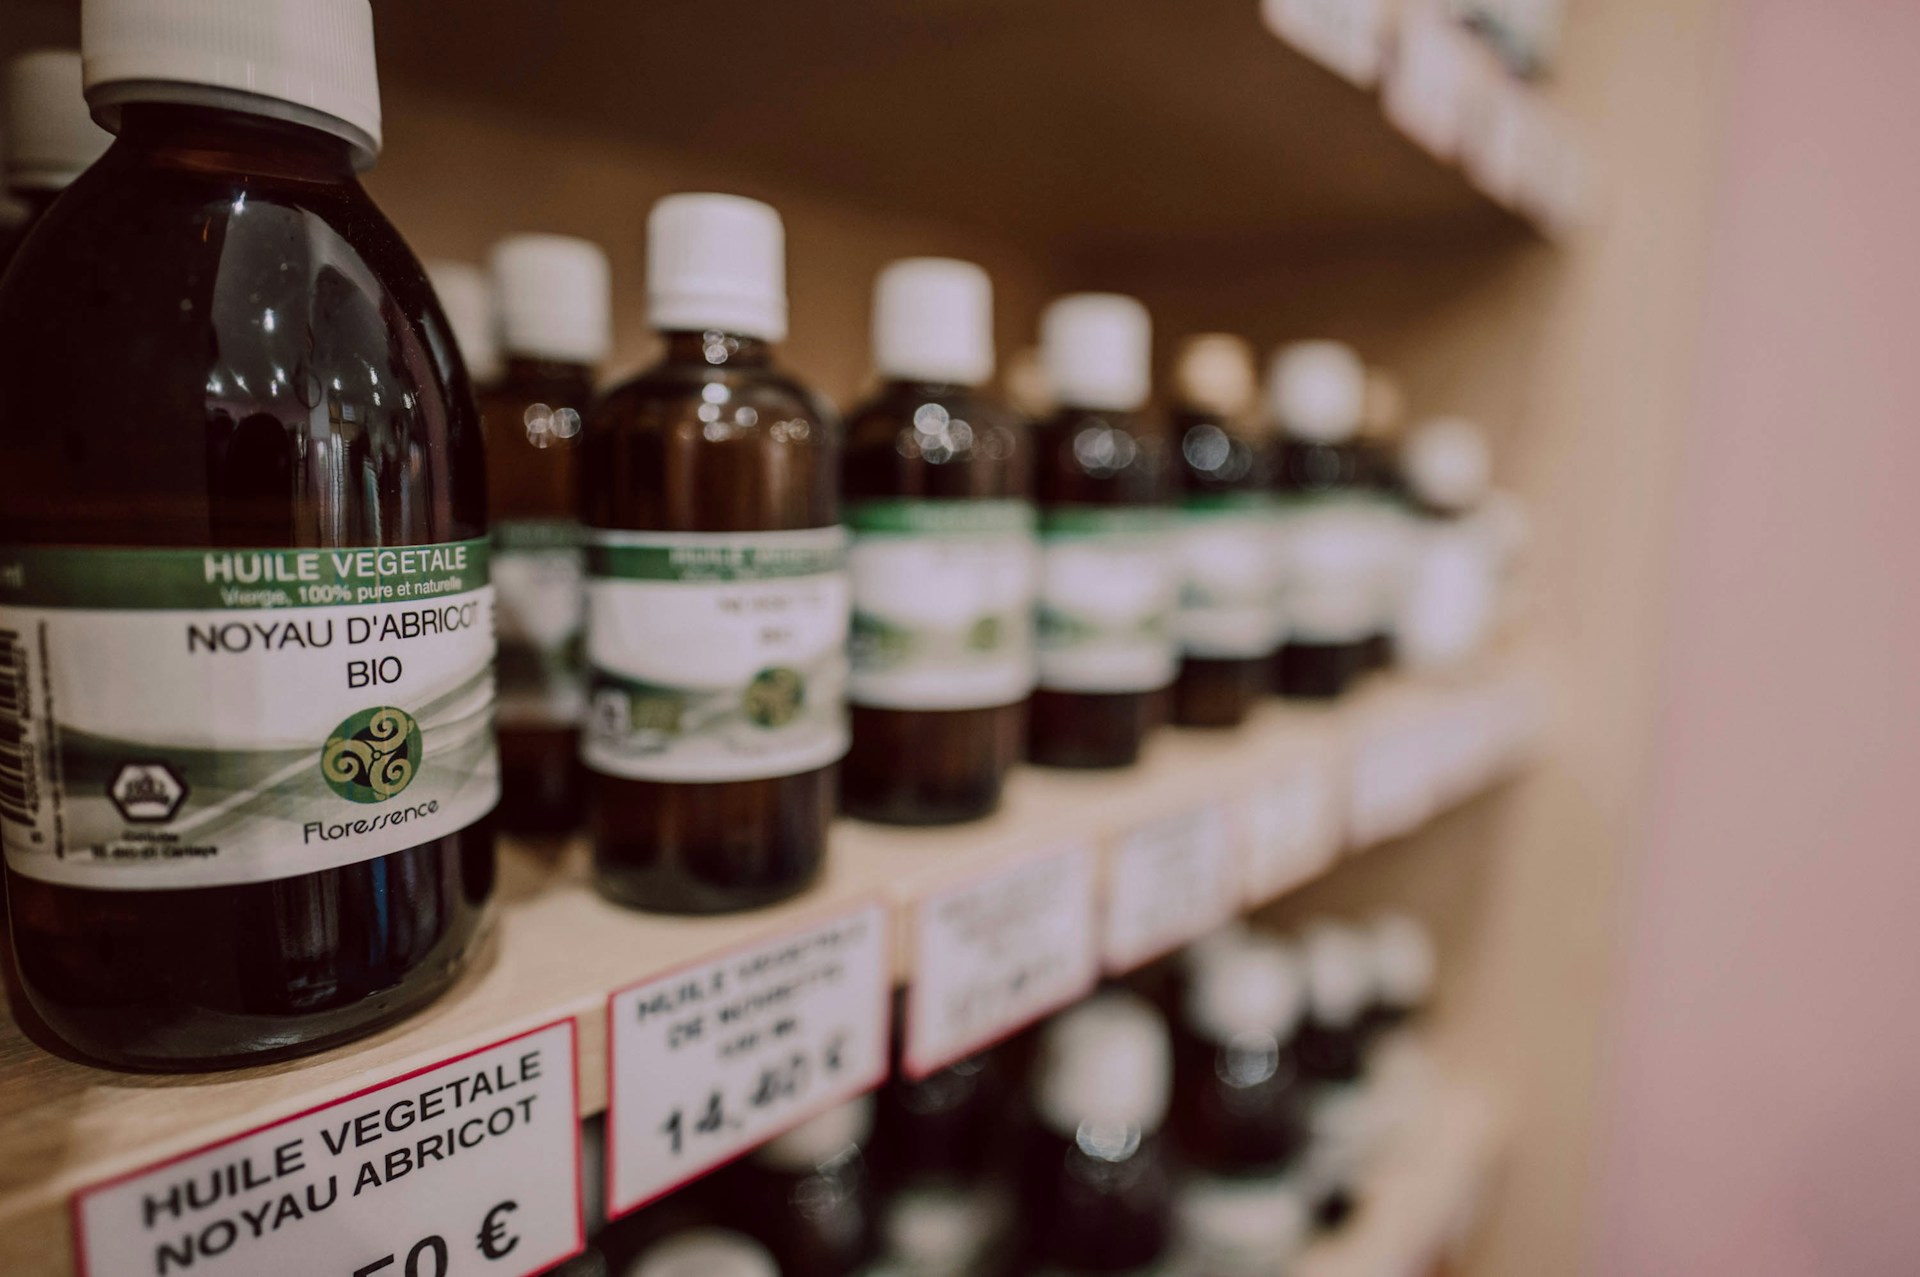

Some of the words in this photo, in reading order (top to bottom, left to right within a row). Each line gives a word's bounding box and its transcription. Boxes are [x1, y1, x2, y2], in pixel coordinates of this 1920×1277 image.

[203, 552, 321, 584] HUILE
[331, 546, 468, 578] VEGETALE
[298, 584, 352, 604] 100%
[357, 583, 393, 603] pure
[397, 582, 411, 596] et
[414, 576, 462, 594] naturelle
[187, 619, 333, 654] NOYAU
[347, 602, 478, 645] D'ABRICOT
[347, 655, 403, 689] BIO
[302, 799, 440, 845] Floressence
[141, 1140, 305, 1229] HUILE
[319, 1050, 543, 1157] VEGETALE
[155, 1176, 339, 1277] NOYAU
[353, 1095, 540, 1197] ABRICOT
[477, 1200, 521, 1260] €
